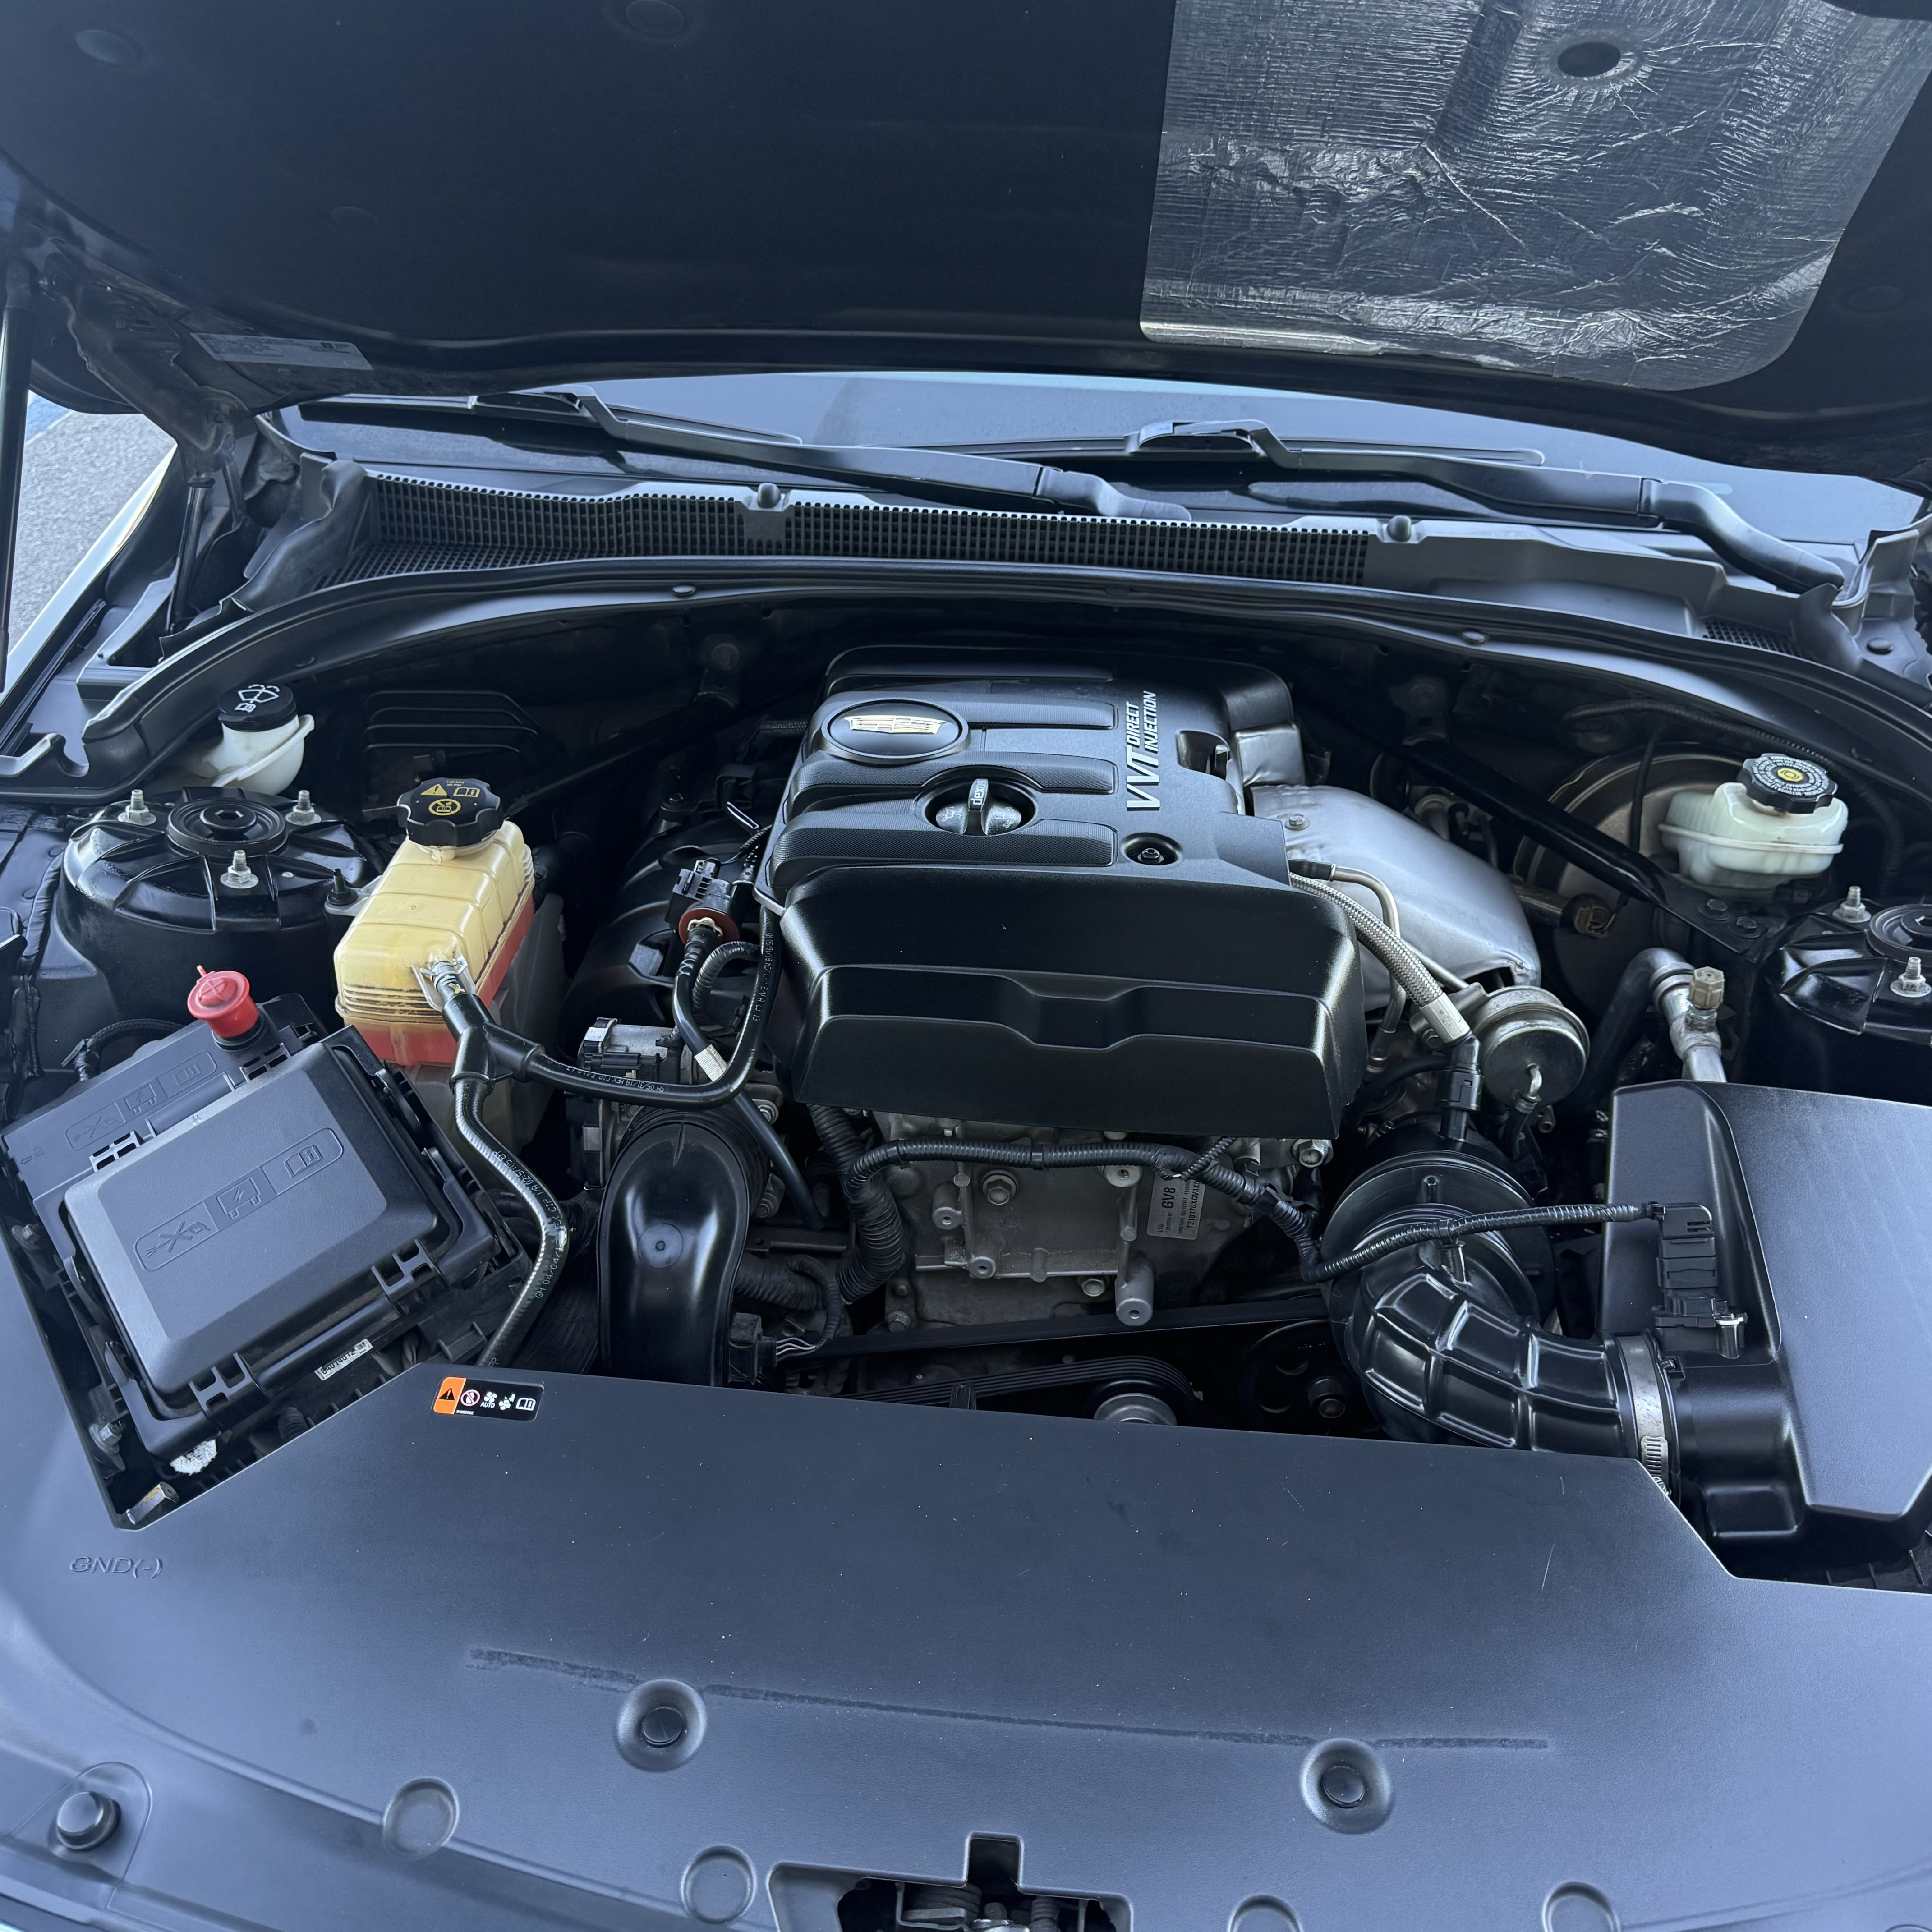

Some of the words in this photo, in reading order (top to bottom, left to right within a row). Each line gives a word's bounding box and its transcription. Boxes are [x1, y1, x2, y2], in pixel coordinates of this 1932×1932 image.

[1126, 701, 1140, 747] DIRECT
[1143, 690, 1159, 754] INJECTION
[1127, 745, 1160, 811] VVT
[506, 1159, 534, 1185] 02:57:05
[543, 1199, 557, 1212] CIP
[1161, 1187, 1176, 1209] GV8
[535, 1287, 547, 1298] GM
[69, 1556, 163, 1579] GND(-)
